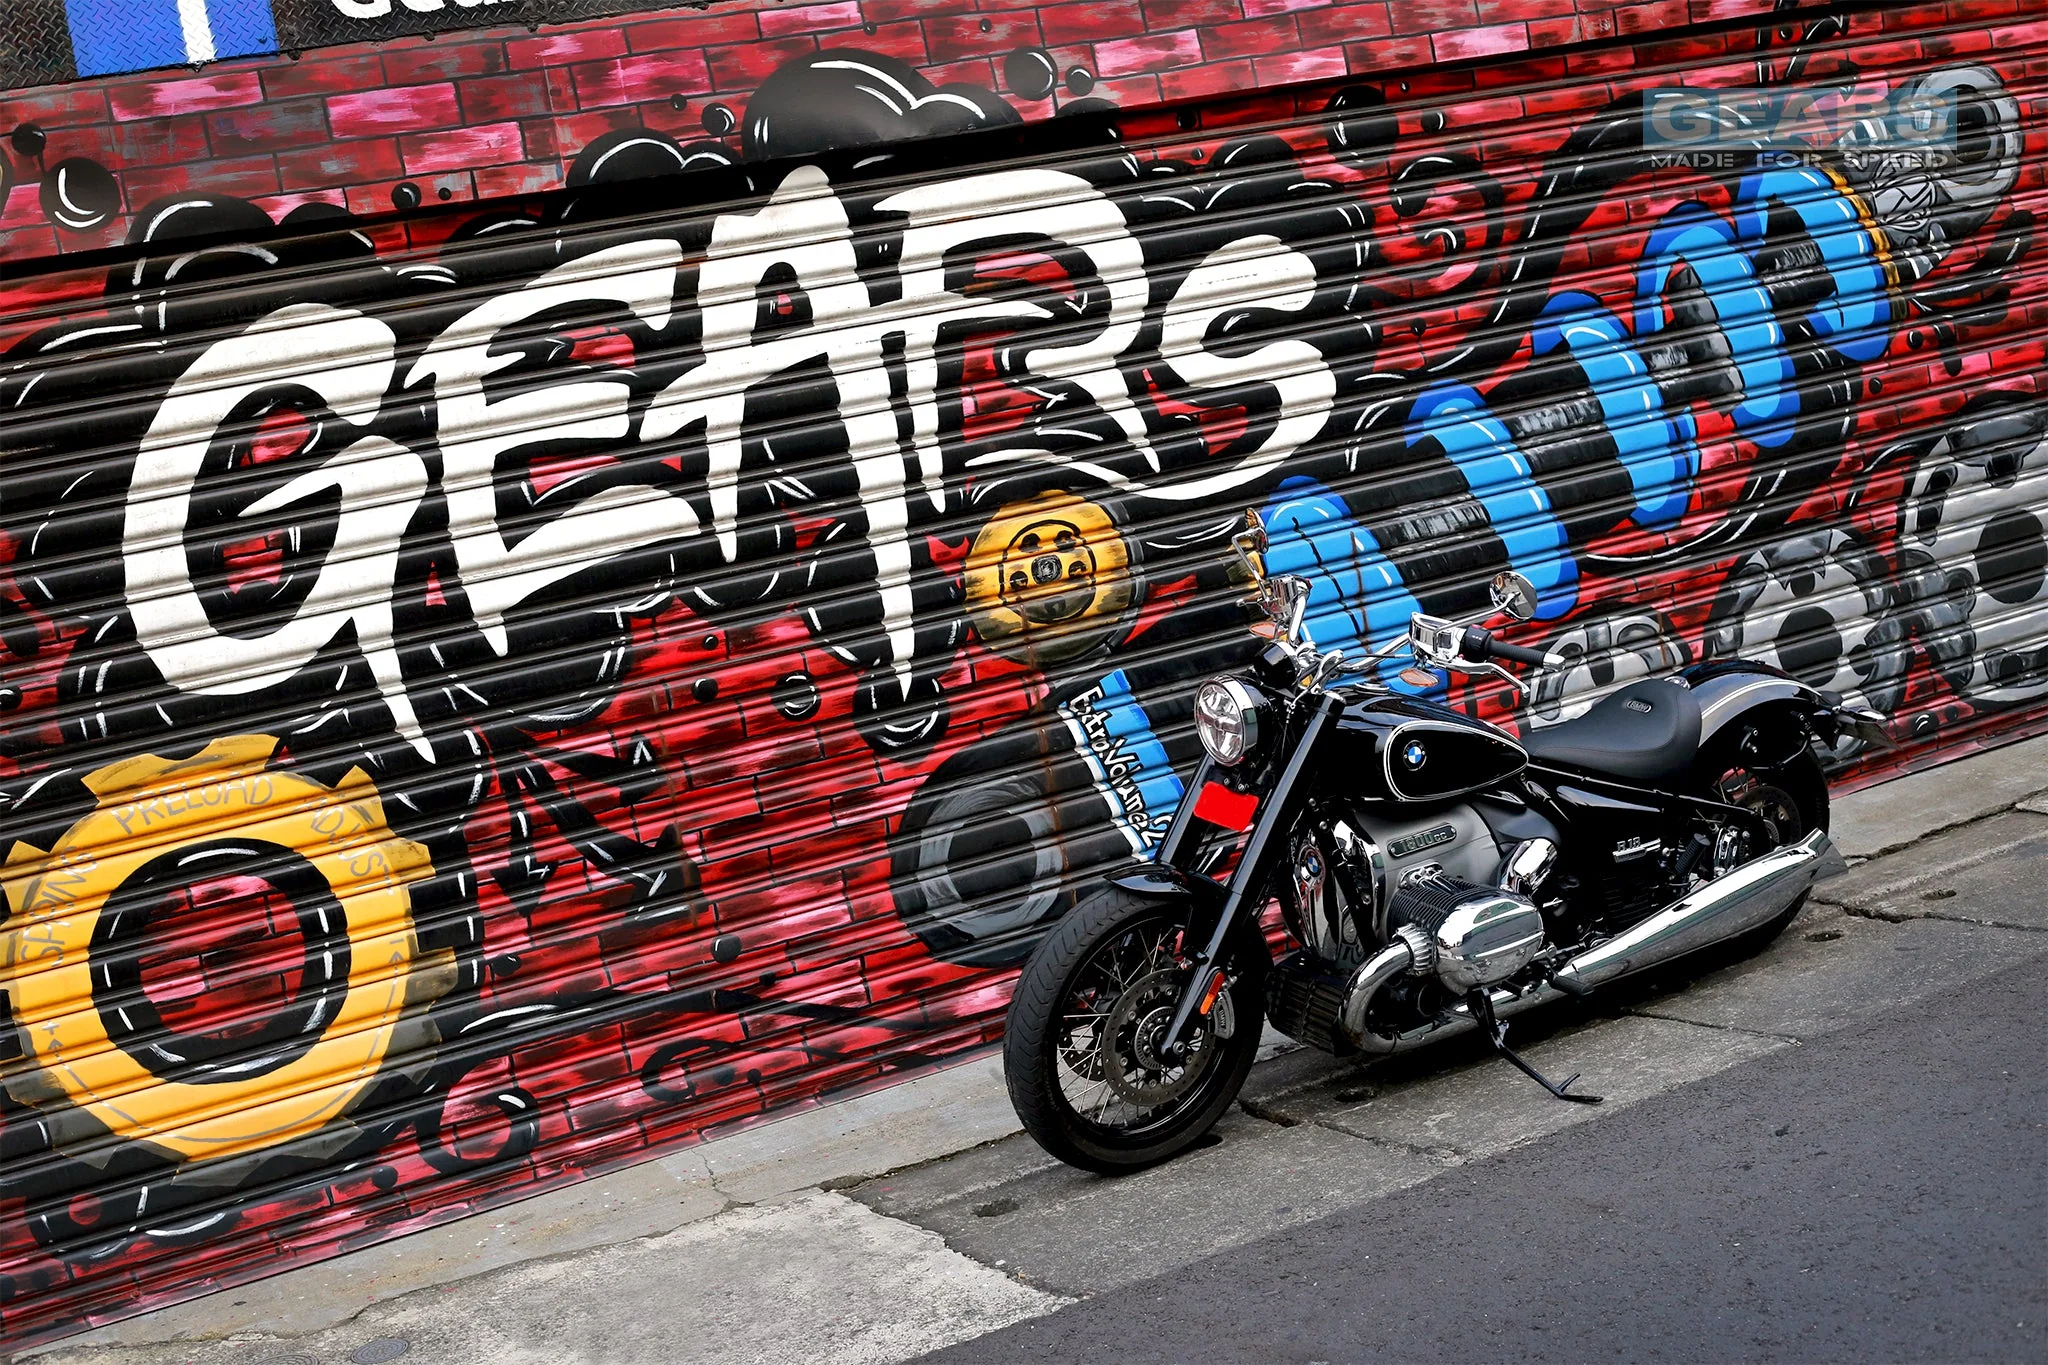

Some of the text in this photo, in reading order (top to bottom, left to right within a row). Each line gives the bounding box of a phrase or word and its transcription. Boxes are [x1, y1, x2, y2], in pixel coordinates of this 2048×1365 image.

[124, 166, 1337, 763] GEARS
[110, 771, 274, 835] PRELOAD
[294, 796, 395, 896] ADJUST
[20, 846, 98, 968] SPRING
